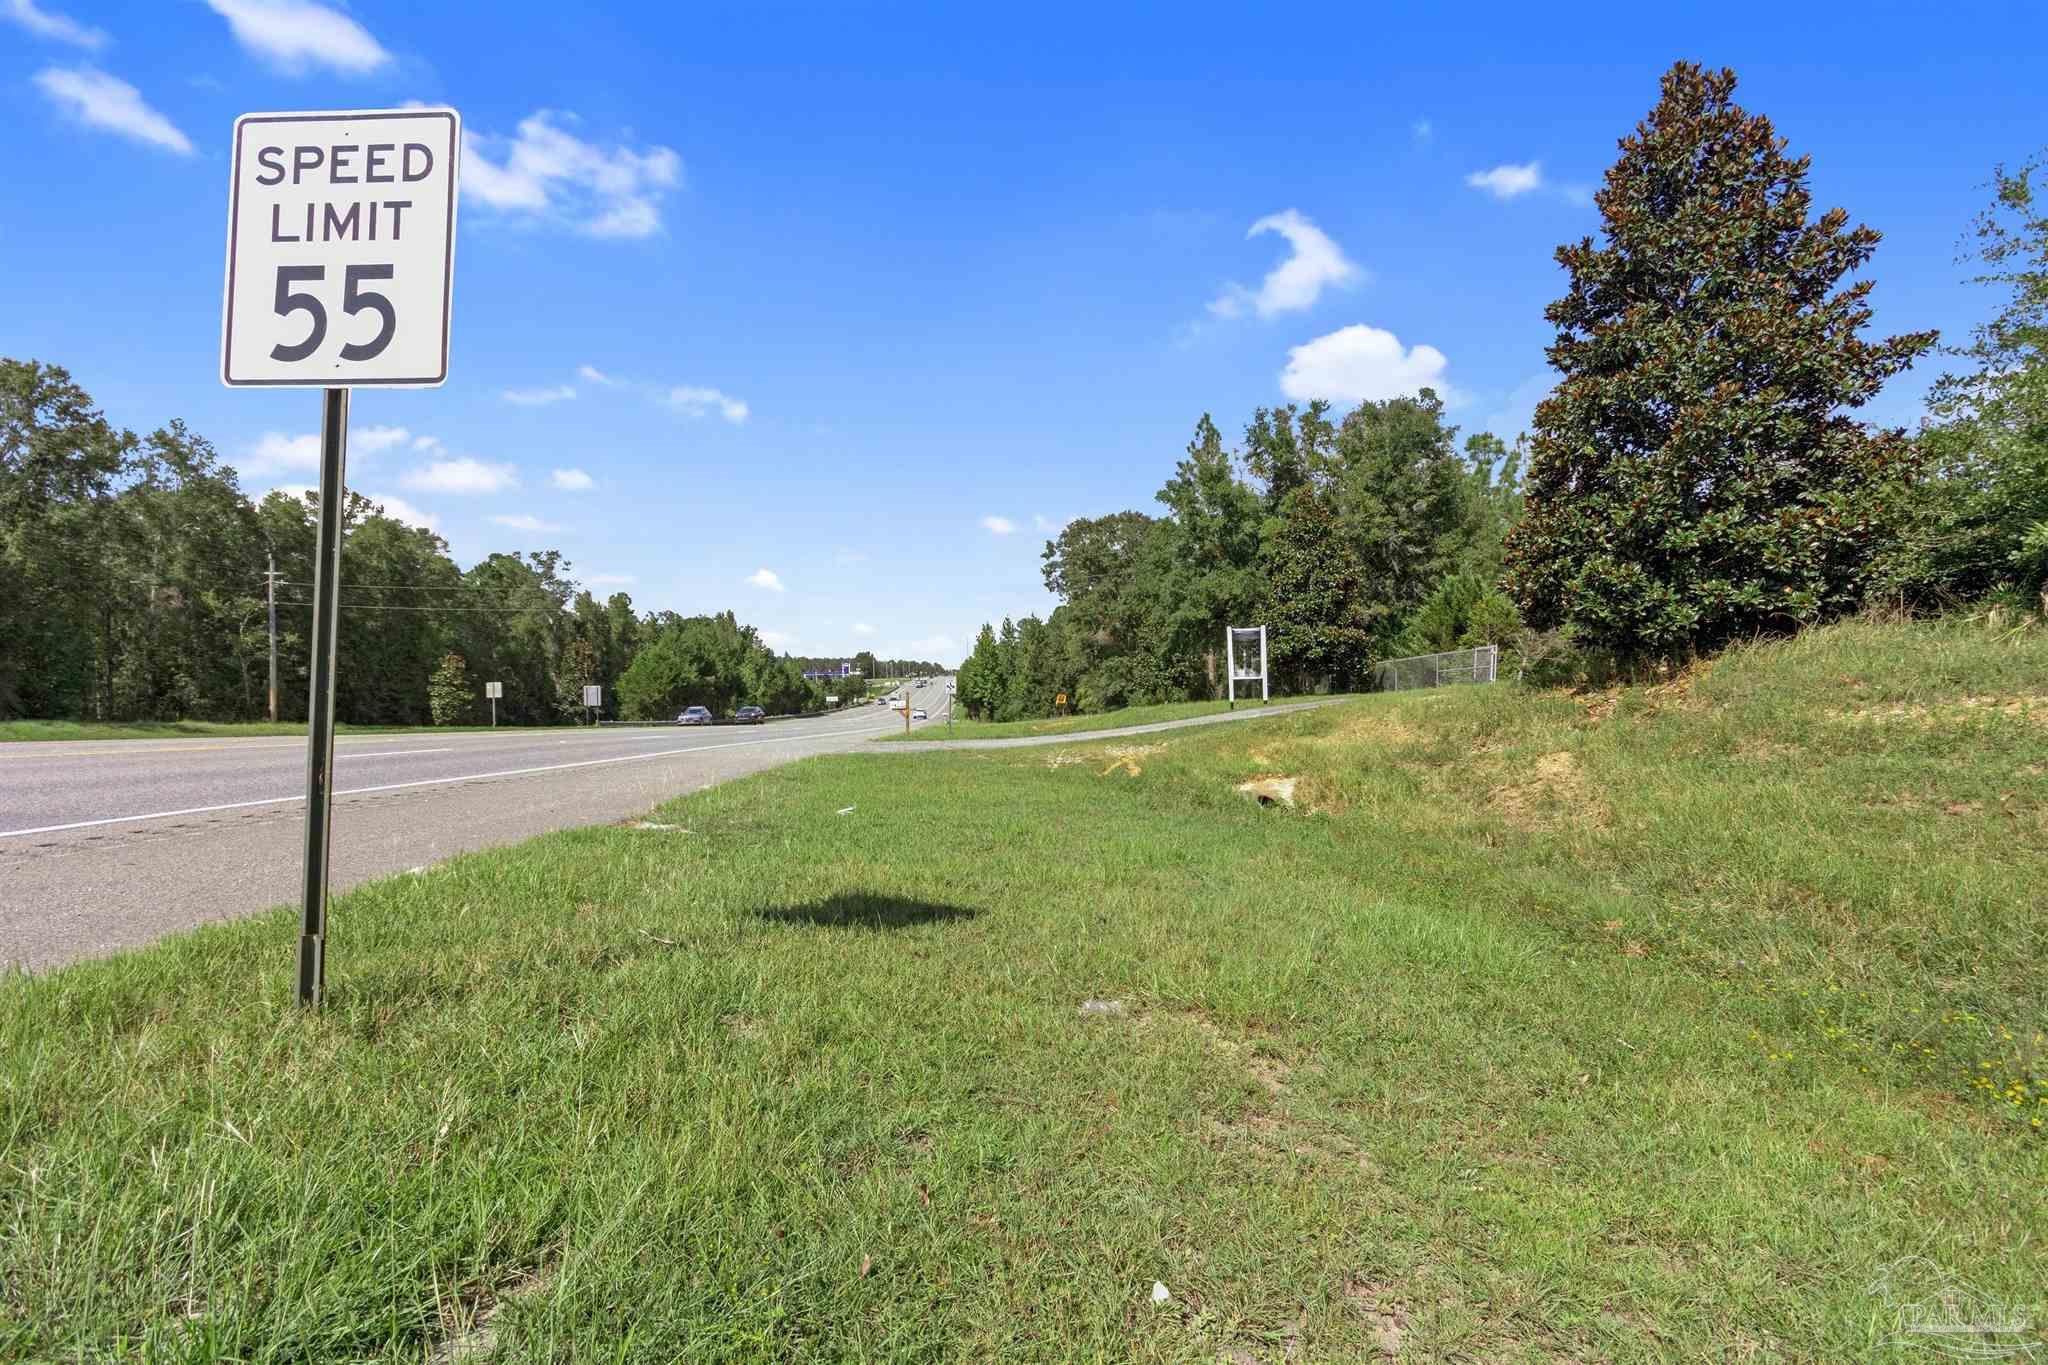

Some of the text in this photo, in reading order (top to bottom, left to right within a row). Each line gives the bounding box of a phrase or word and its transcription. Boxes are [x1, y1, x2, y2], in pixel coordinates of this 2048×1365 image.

[255, 142, 434, 186] SPEED
[271, 200, 413, 243] LIMIT
[269, 263, 397, 362] 55
